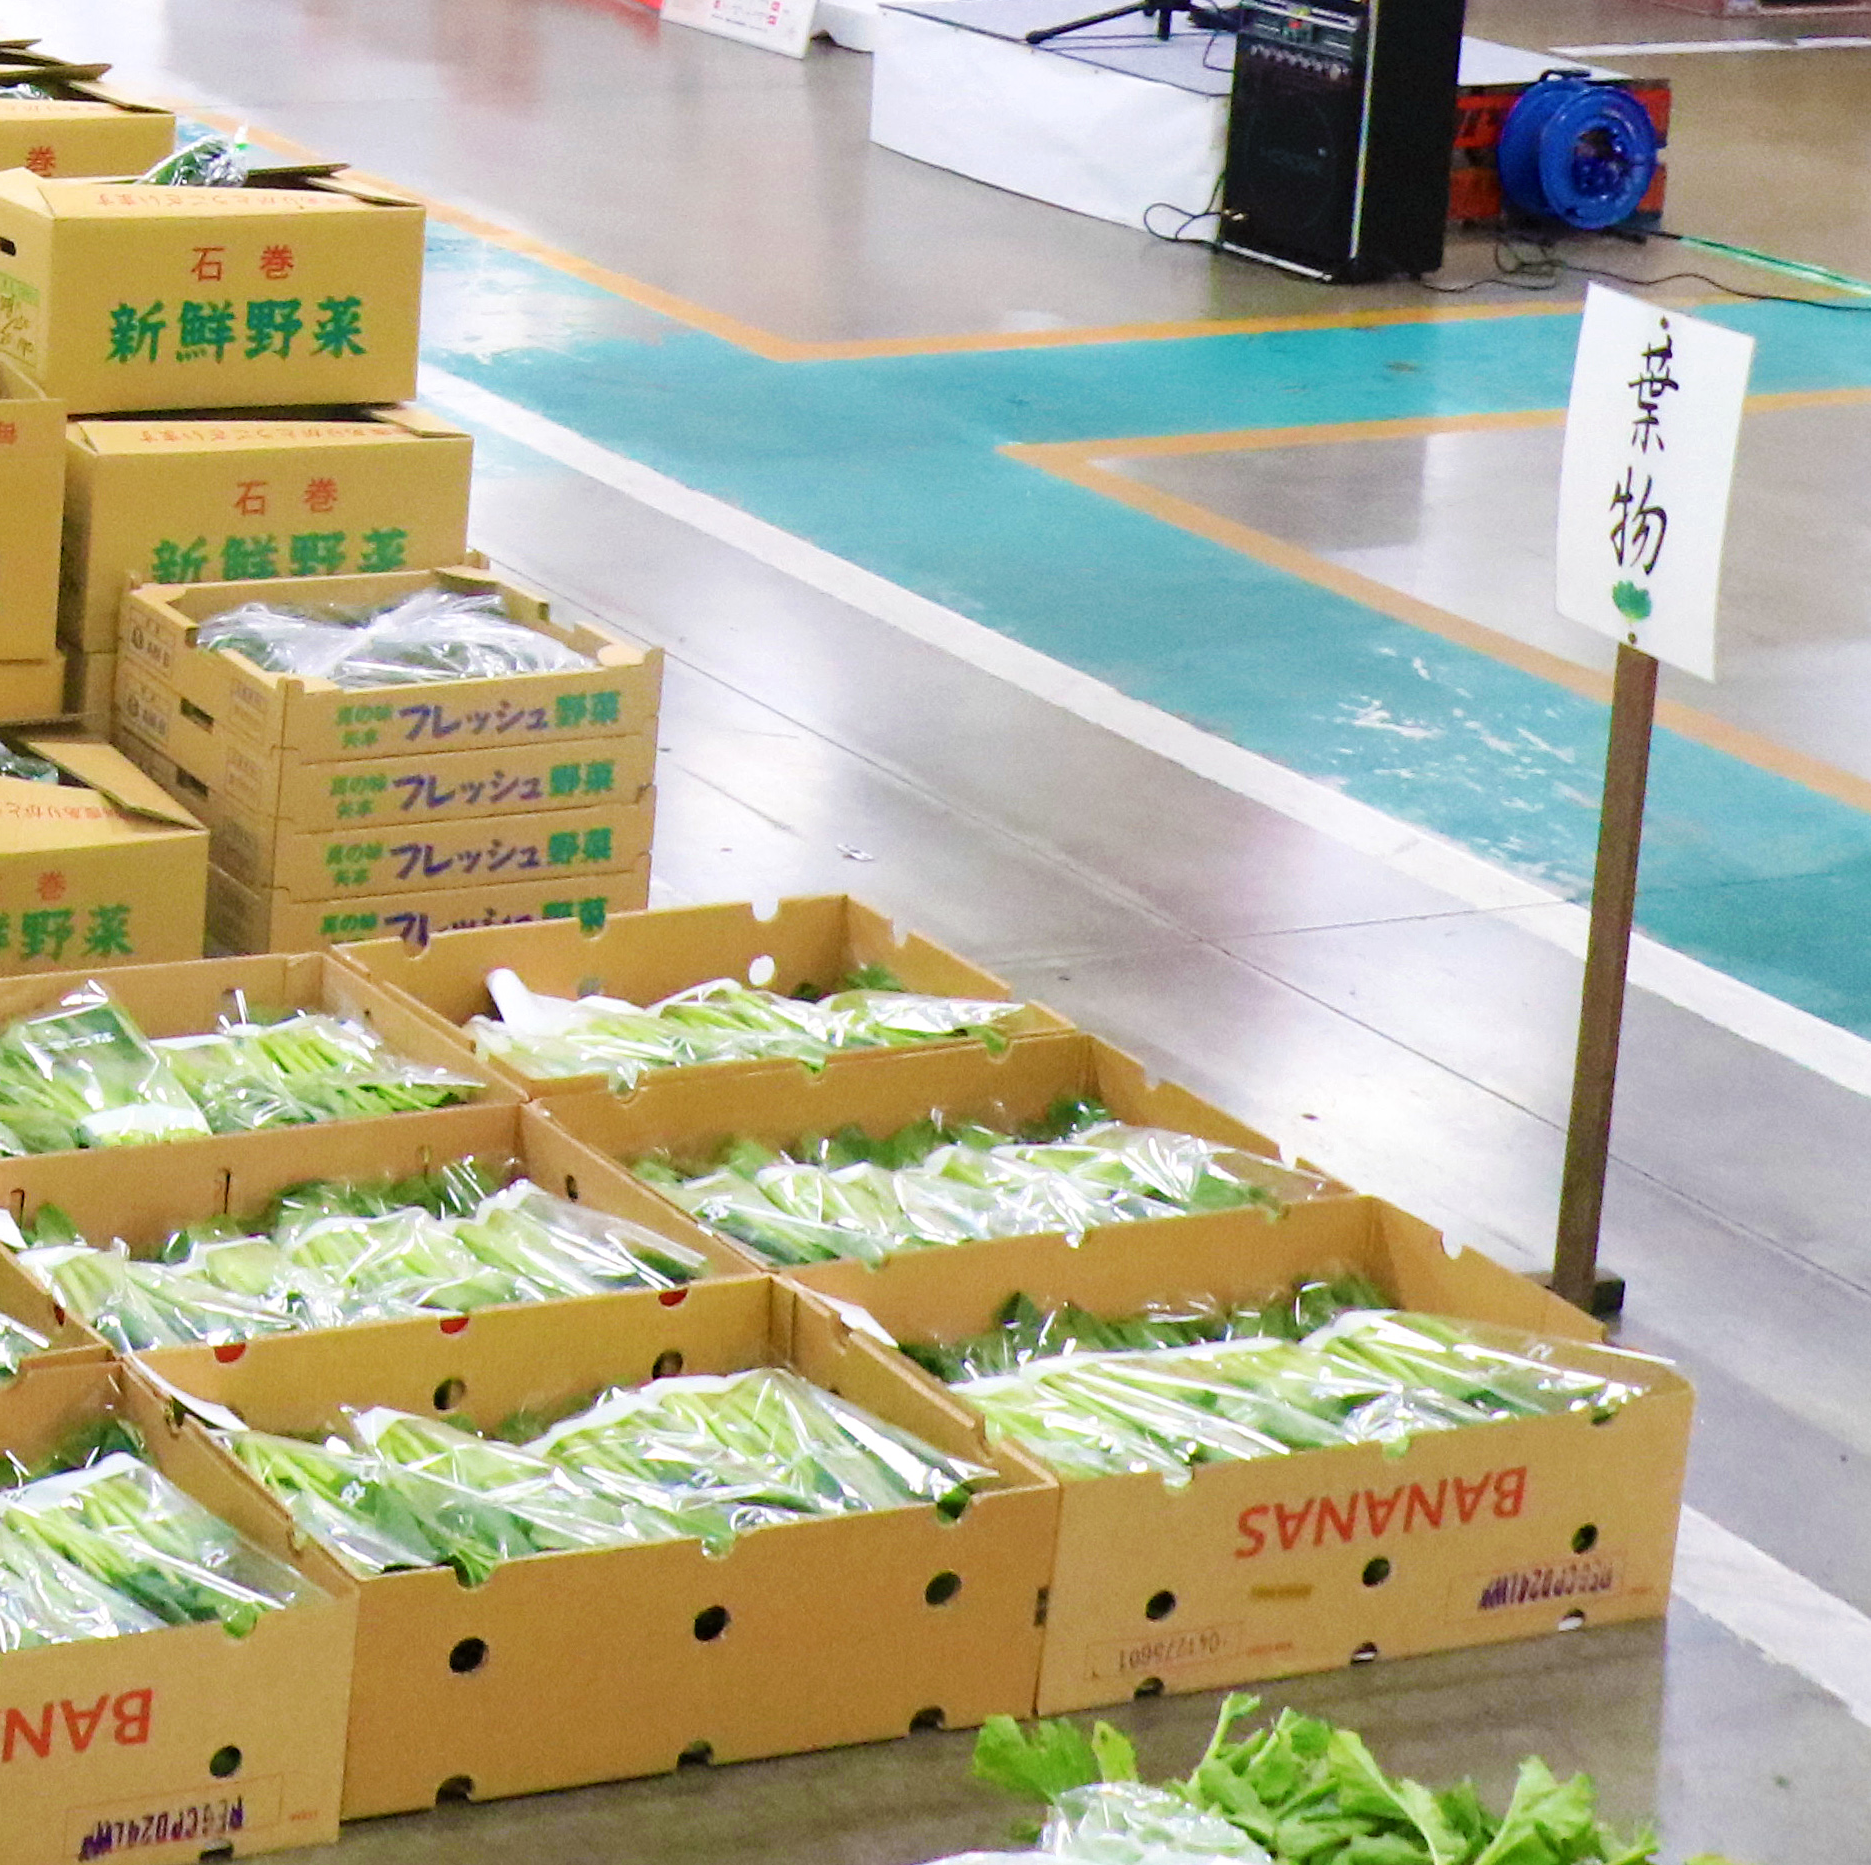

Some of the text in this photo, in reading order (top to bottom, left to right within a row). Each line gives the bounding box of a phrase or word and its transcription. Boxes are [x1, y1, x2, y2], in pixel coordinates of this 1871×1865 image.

[190, 244, 296, 283] 石巻
[106, 295, 368, 366] 新鮮野菜
[1609, 334, 1680, 576] 葉物
[233, 477, 340, 517] 石巻
[1235, 1463, 1530, 1561] BANANAS
